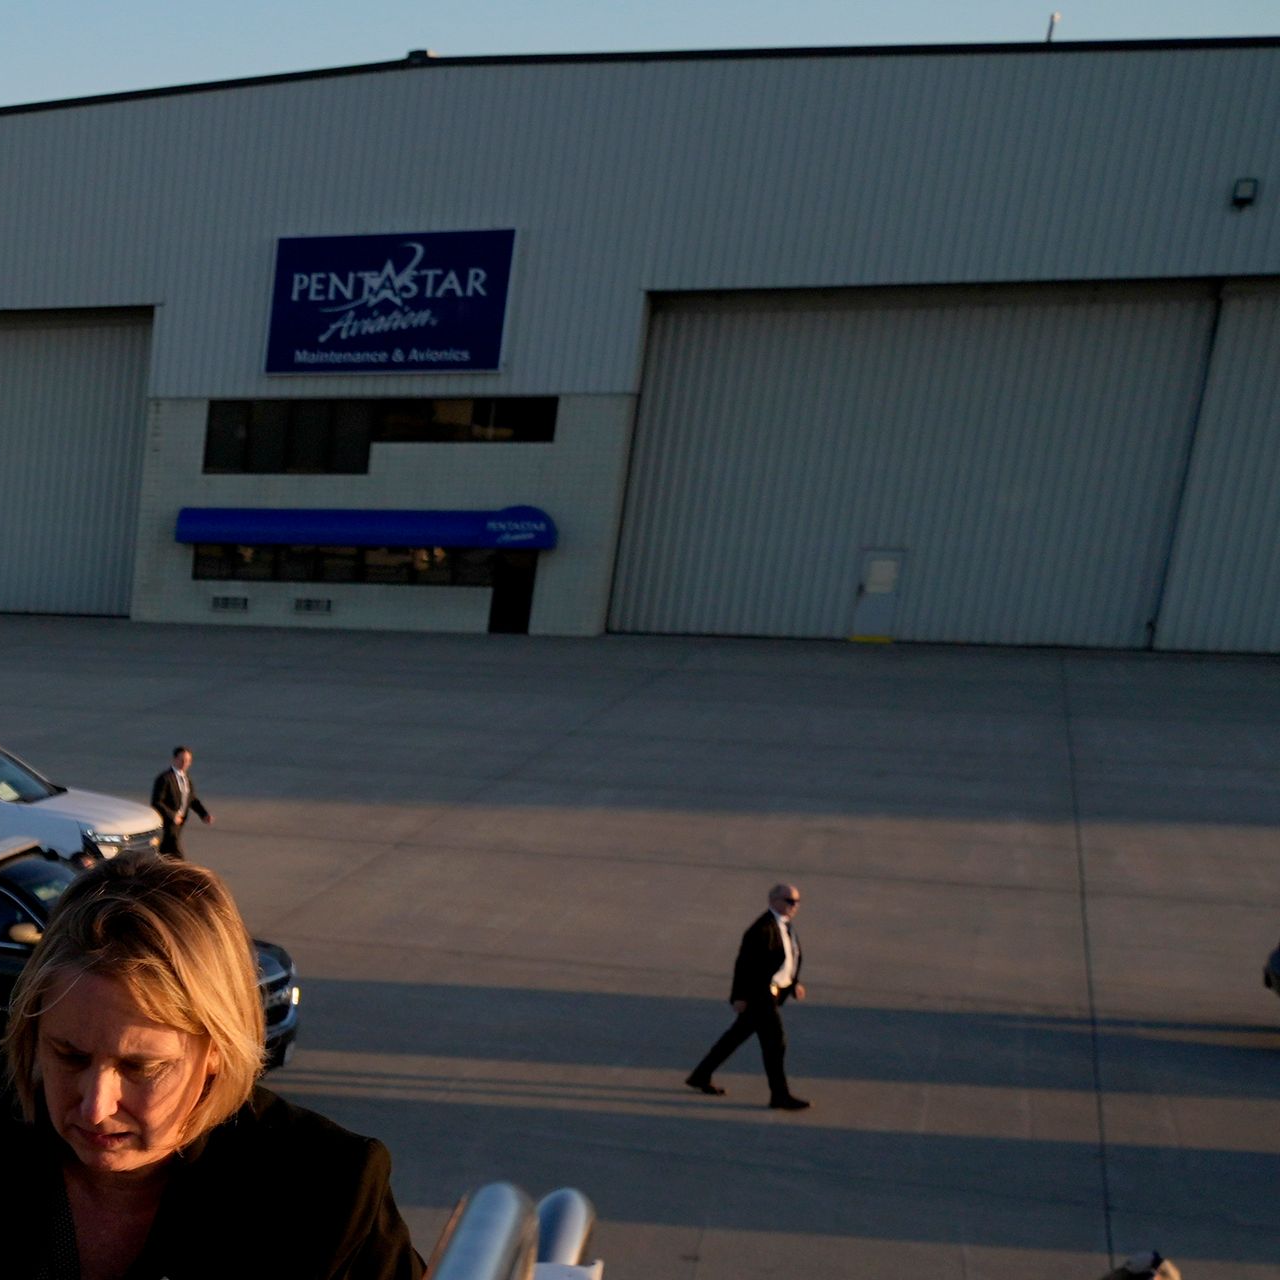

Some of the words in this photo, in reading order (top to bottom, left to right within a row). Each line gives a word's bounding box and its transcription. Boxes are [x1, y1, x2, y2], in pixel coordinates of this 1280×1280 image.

[290, 260, 488, 305] PENTASTAR
[294, 348, 388, 364] Maintenance
[392, 349, 405, 363] &
[406, 347, 471, 363] Avionics
